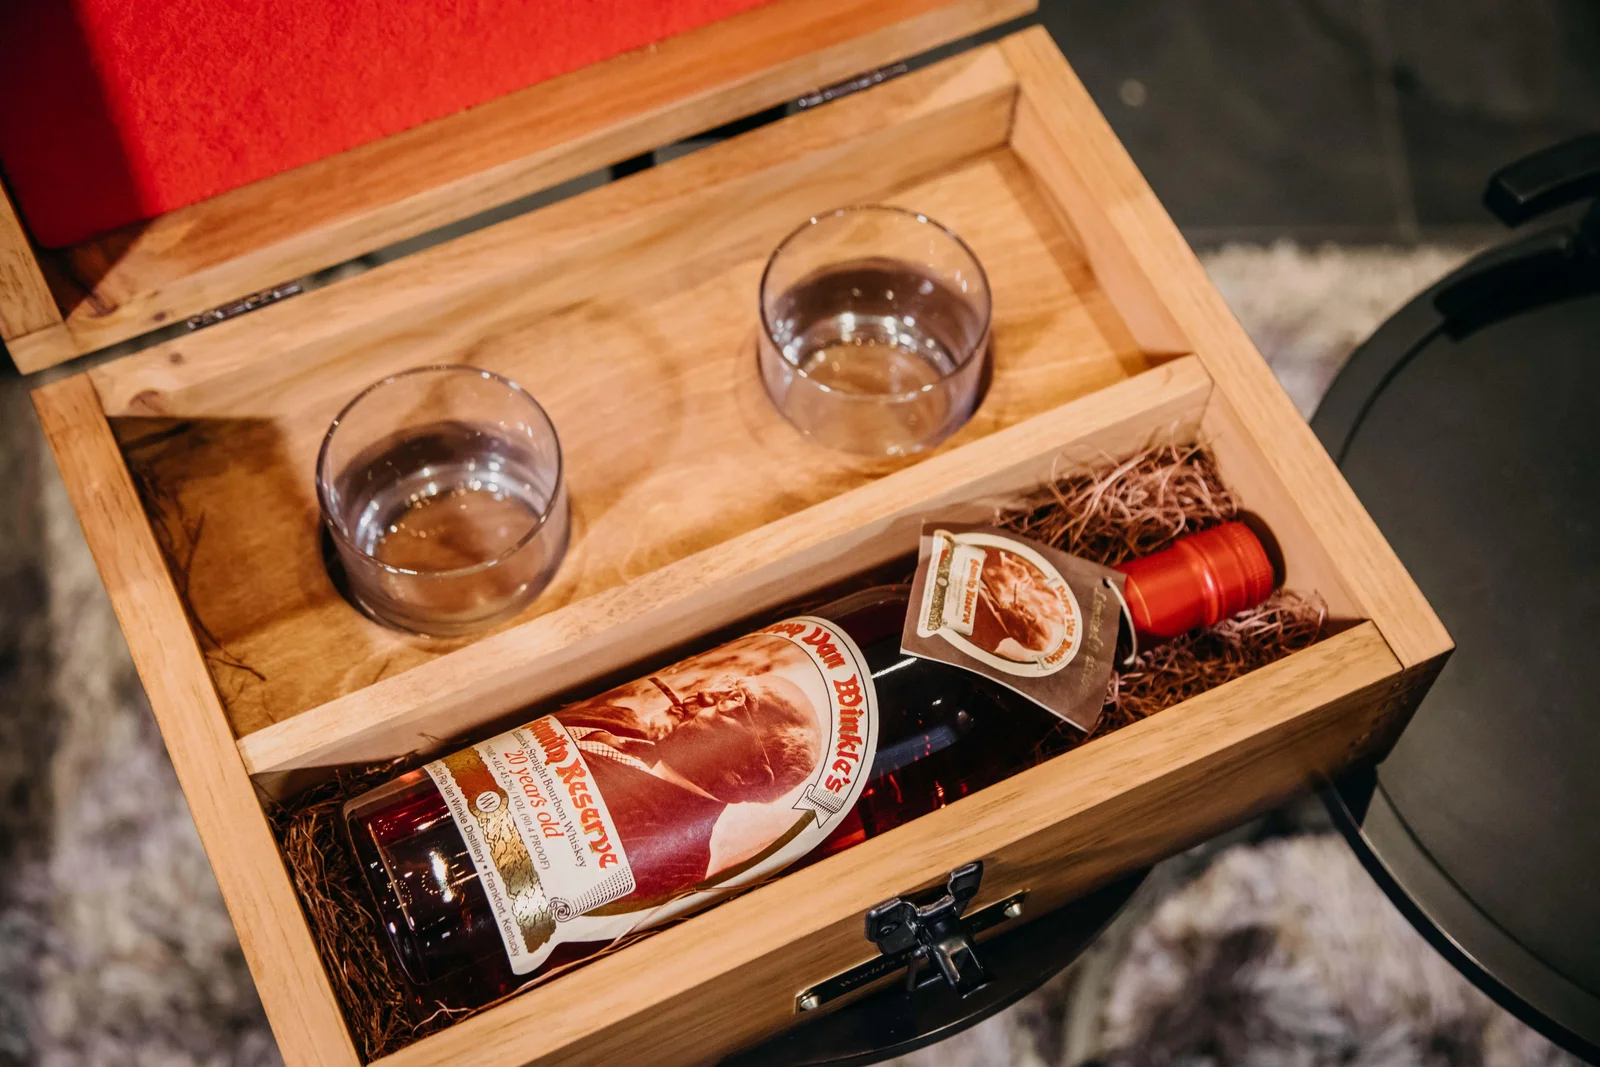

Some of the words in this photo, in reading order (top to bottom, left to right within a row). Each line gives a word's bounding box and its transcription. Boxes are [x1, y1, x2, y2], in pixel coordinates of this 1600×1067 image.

[504, 750, 529, 764] 20
[802, 626, 846, 670] Van
[825, 673, 866, 794] Winkle's
[492, 760, 506, 771] ALC
[512, 795, 526, 812] VOL
[519, 812, 535, 834] (90.4
[529, 834, 551, 871] PROOF)
[509, 767, 548, 809] years
[526, 748, 549, 779] Straight
[543, 778, 567, 821] Bourbon
[563, 821, 587, 868] Whiskey
[536, 811, 565, 839] old
[555, 757, 619, 869] Reserve
[438, 774, 448, 786] Rip
[443, 783, 455, 799] Van
[450, 795, 468, 824] Winkle
[463, 824, 486, 863] Distillery
[484, 871, 507, 918] Frankfort,
[501, 917, 521, 958] Kentucky
